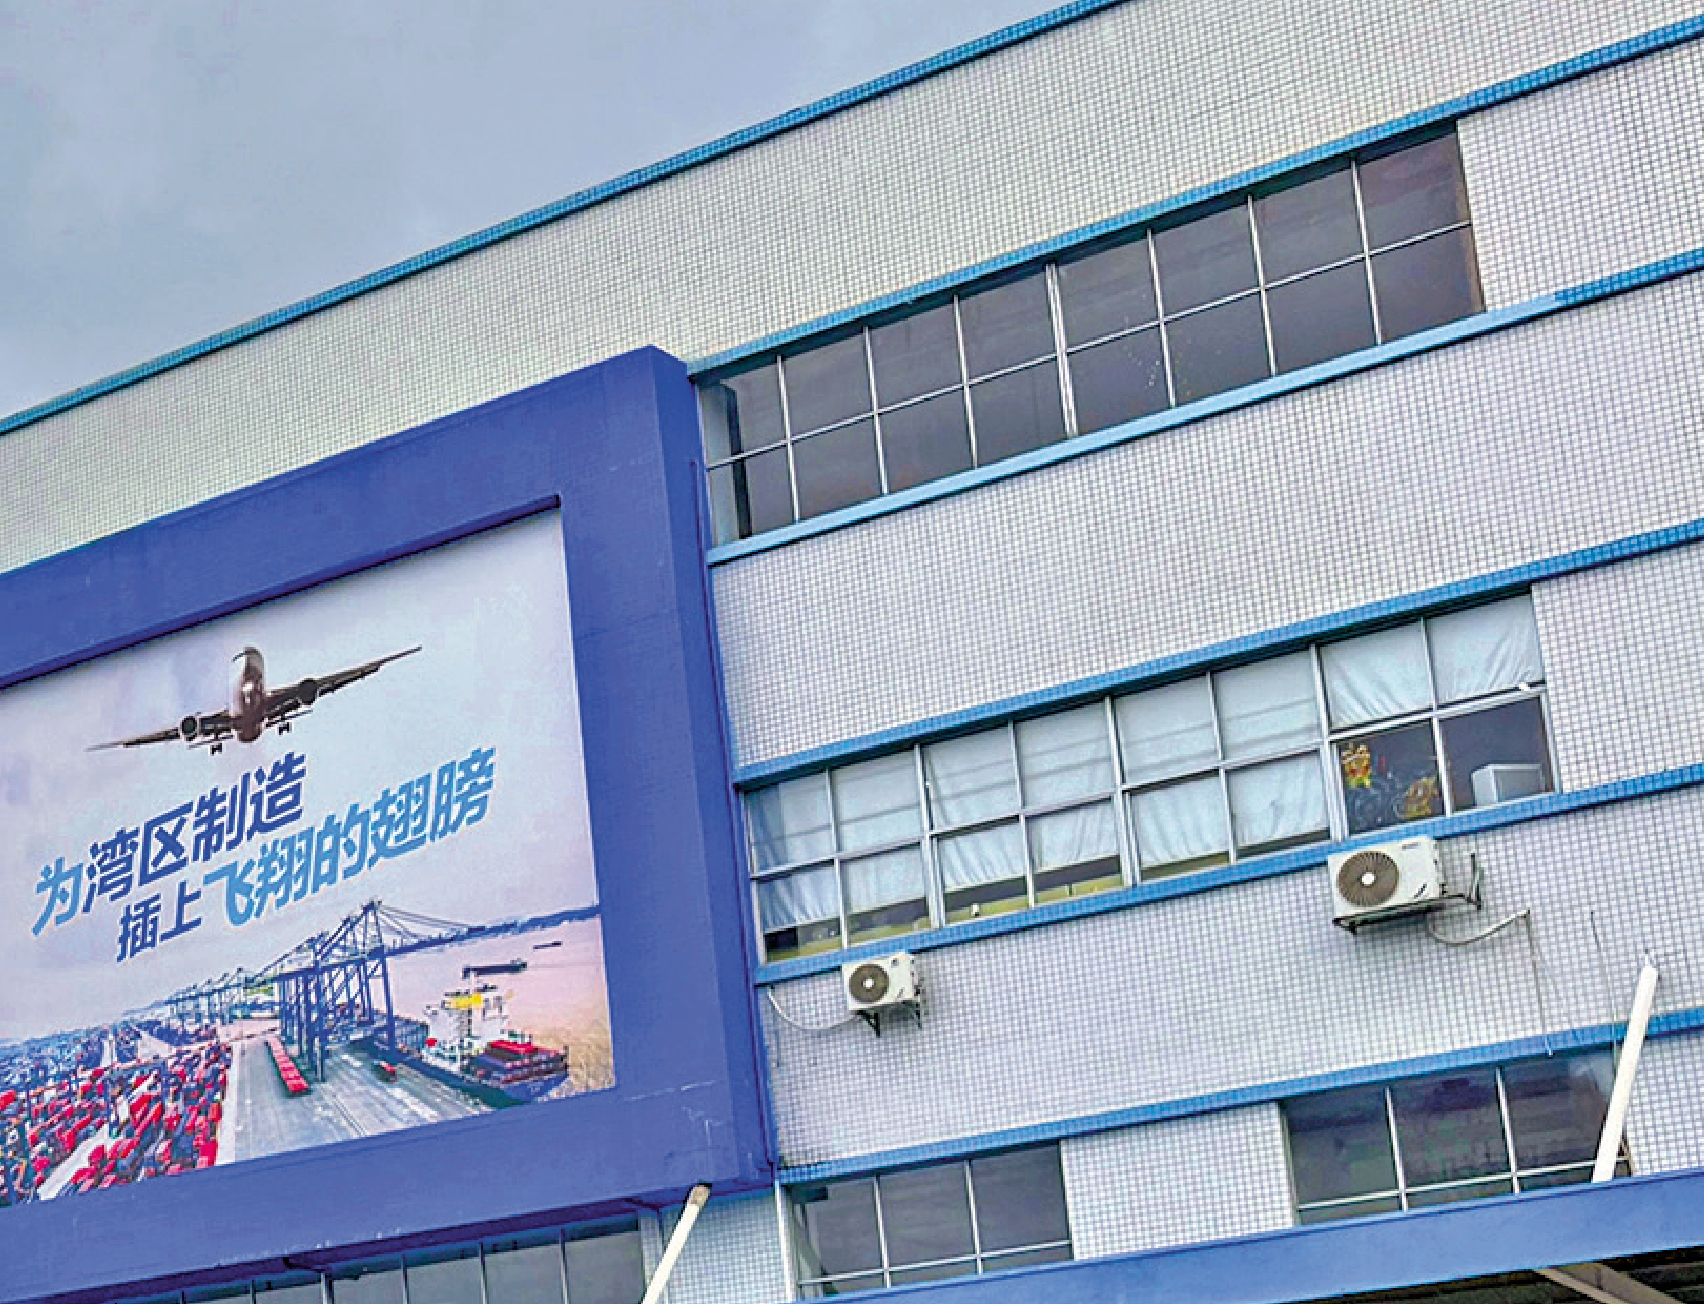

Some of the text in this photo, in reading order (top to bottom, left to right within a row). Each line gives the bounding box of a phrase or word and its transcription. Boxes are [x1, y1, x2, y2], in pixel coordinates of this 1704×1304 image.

[32, 752, 306, 936] 为湾区制造
[116, 747, 496, 962] 插上飞翔的翅膀
